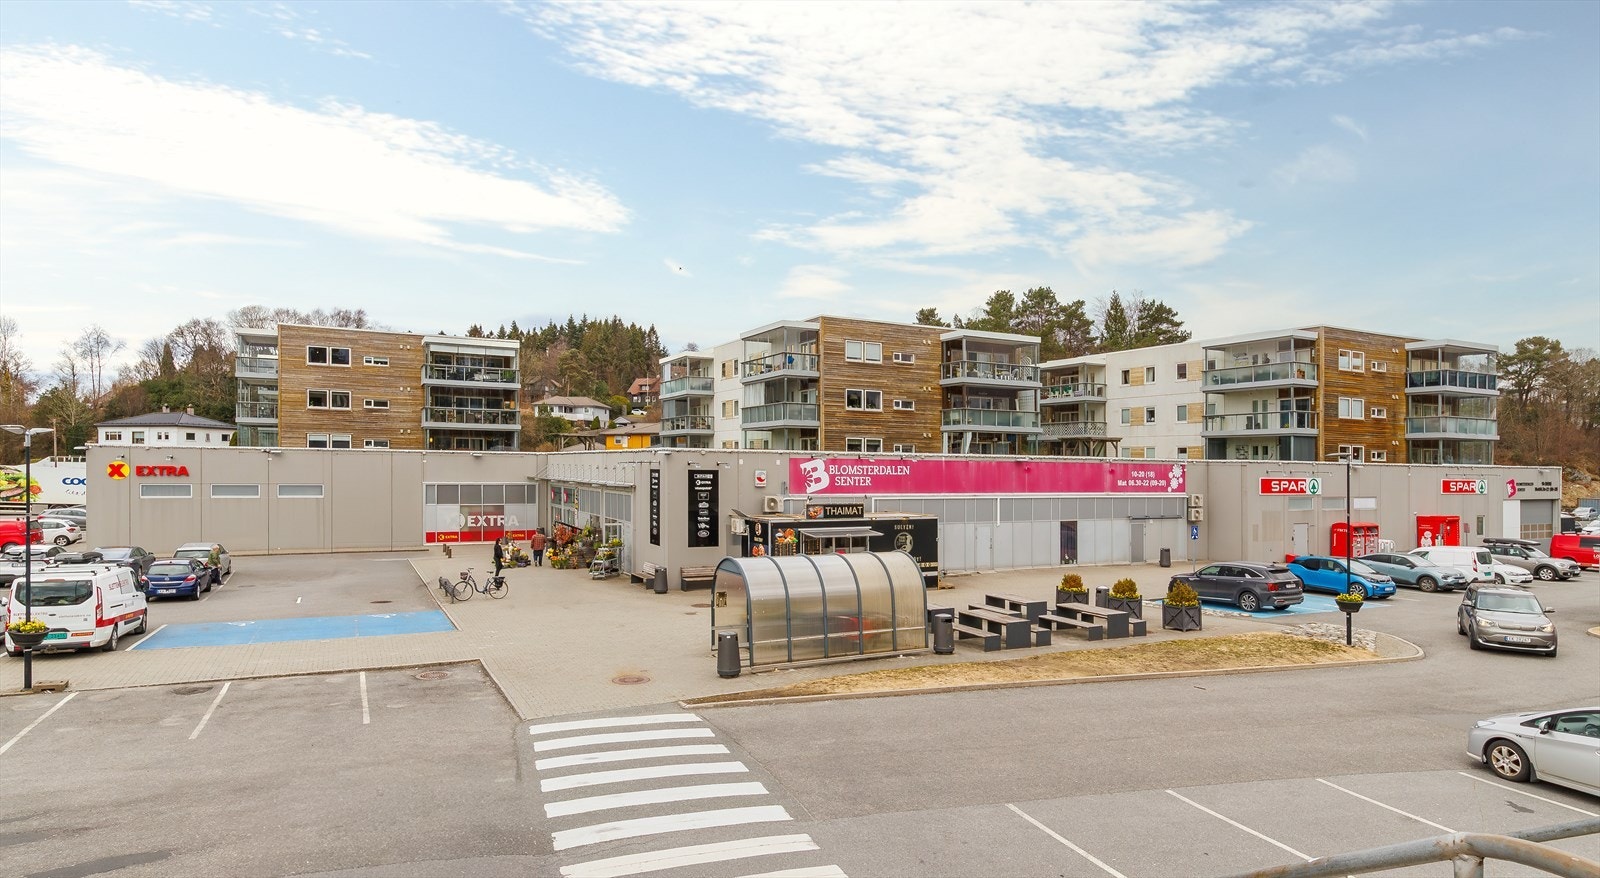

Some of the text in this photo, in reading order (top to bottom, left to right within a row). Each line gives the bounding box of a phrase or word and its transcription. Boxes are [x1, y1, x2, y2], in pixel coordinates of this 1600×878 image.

[136, 465, 189, 477] EXTRA
[829, 465, 910, 475] BLOMSTERDALEN
[835, 476, 872, 486] SENTER
[1271, 481, 1306, 492] SPAR
[1450, 480, 1476, 491] SPAR
[825, 506, 864, 516] THAIMAT
[467, 515, 519, 527] EXTRA
